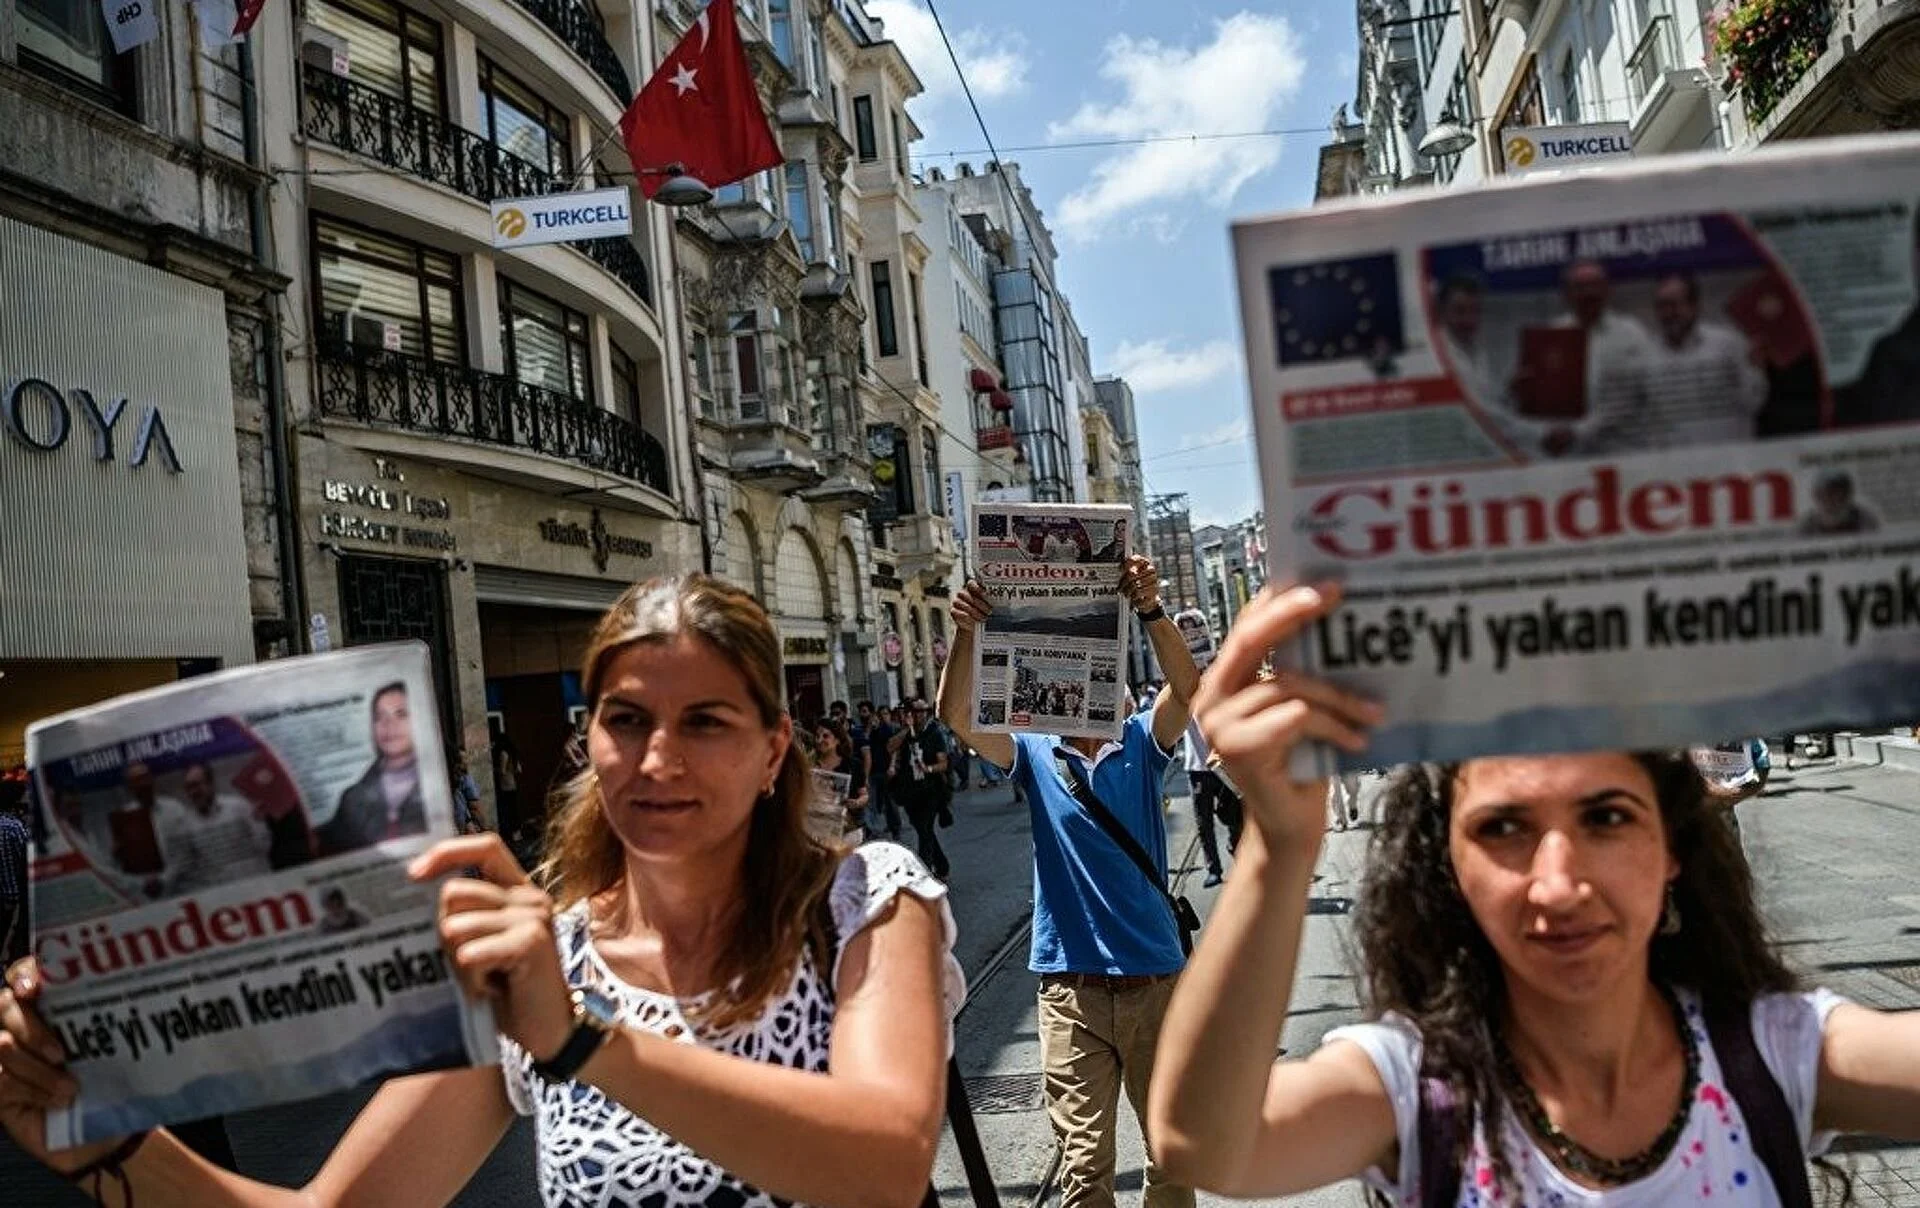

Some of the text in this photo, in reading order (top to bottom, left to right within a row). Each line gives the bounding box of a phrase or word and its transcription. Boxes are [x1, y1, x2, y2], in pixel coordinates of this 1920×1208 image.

[116, 1, 142, 25] CHP
[1541, 136, 1630, 158] TURKCELL
[532, 204, 629, 229] TURKCELL
[1309, 466, 1796, 561] Gündem
[981, 561, 1085, 580] Gündem
[1018, 585, 1050, 600] yakan
[1485, 597, 1630, 673] yakan
[1644, 571, 1823, 648] kendini
[35, 888, 316, 987] Gündem
[153, 994, 242, 1055] yakan
[239, 960, 359, 1026] kendini
